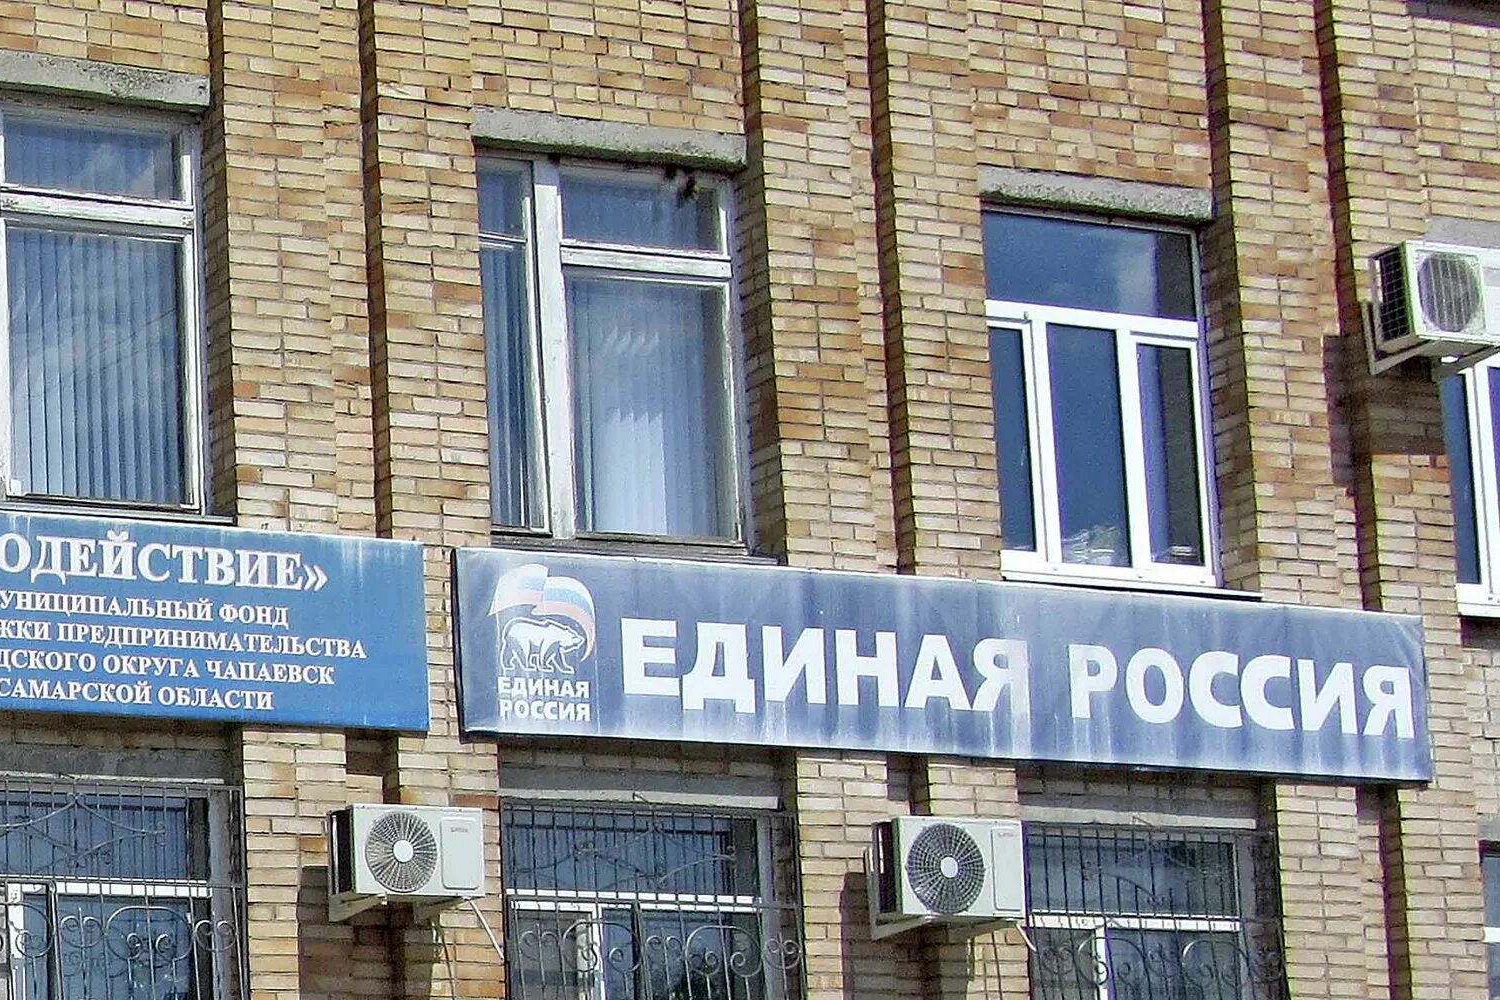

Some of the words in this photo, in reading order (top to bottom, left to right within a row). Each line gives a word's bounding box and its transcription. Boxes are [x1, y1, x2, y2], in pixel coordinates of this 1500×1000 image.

[219, 604, 288, 629] ФОНД
[57, 623, 367, 659] ПРЕДПРИНИМАТЕЛЬСТВА
[102, 654, 200, 678] ОКРУГА
[205, 660, 335, 684] ЧАПАЕВСК
[619, 618, 1028, 714] ЕДИНАЯ
[1069, 644, 1415, 739] РОССИЯ
[157, 687, 275, 710] ОБЛАСТИ
[497, 677, 590, 699] ЕДИНАЯ
[499, 699, 591, 721] РОССИЯ
